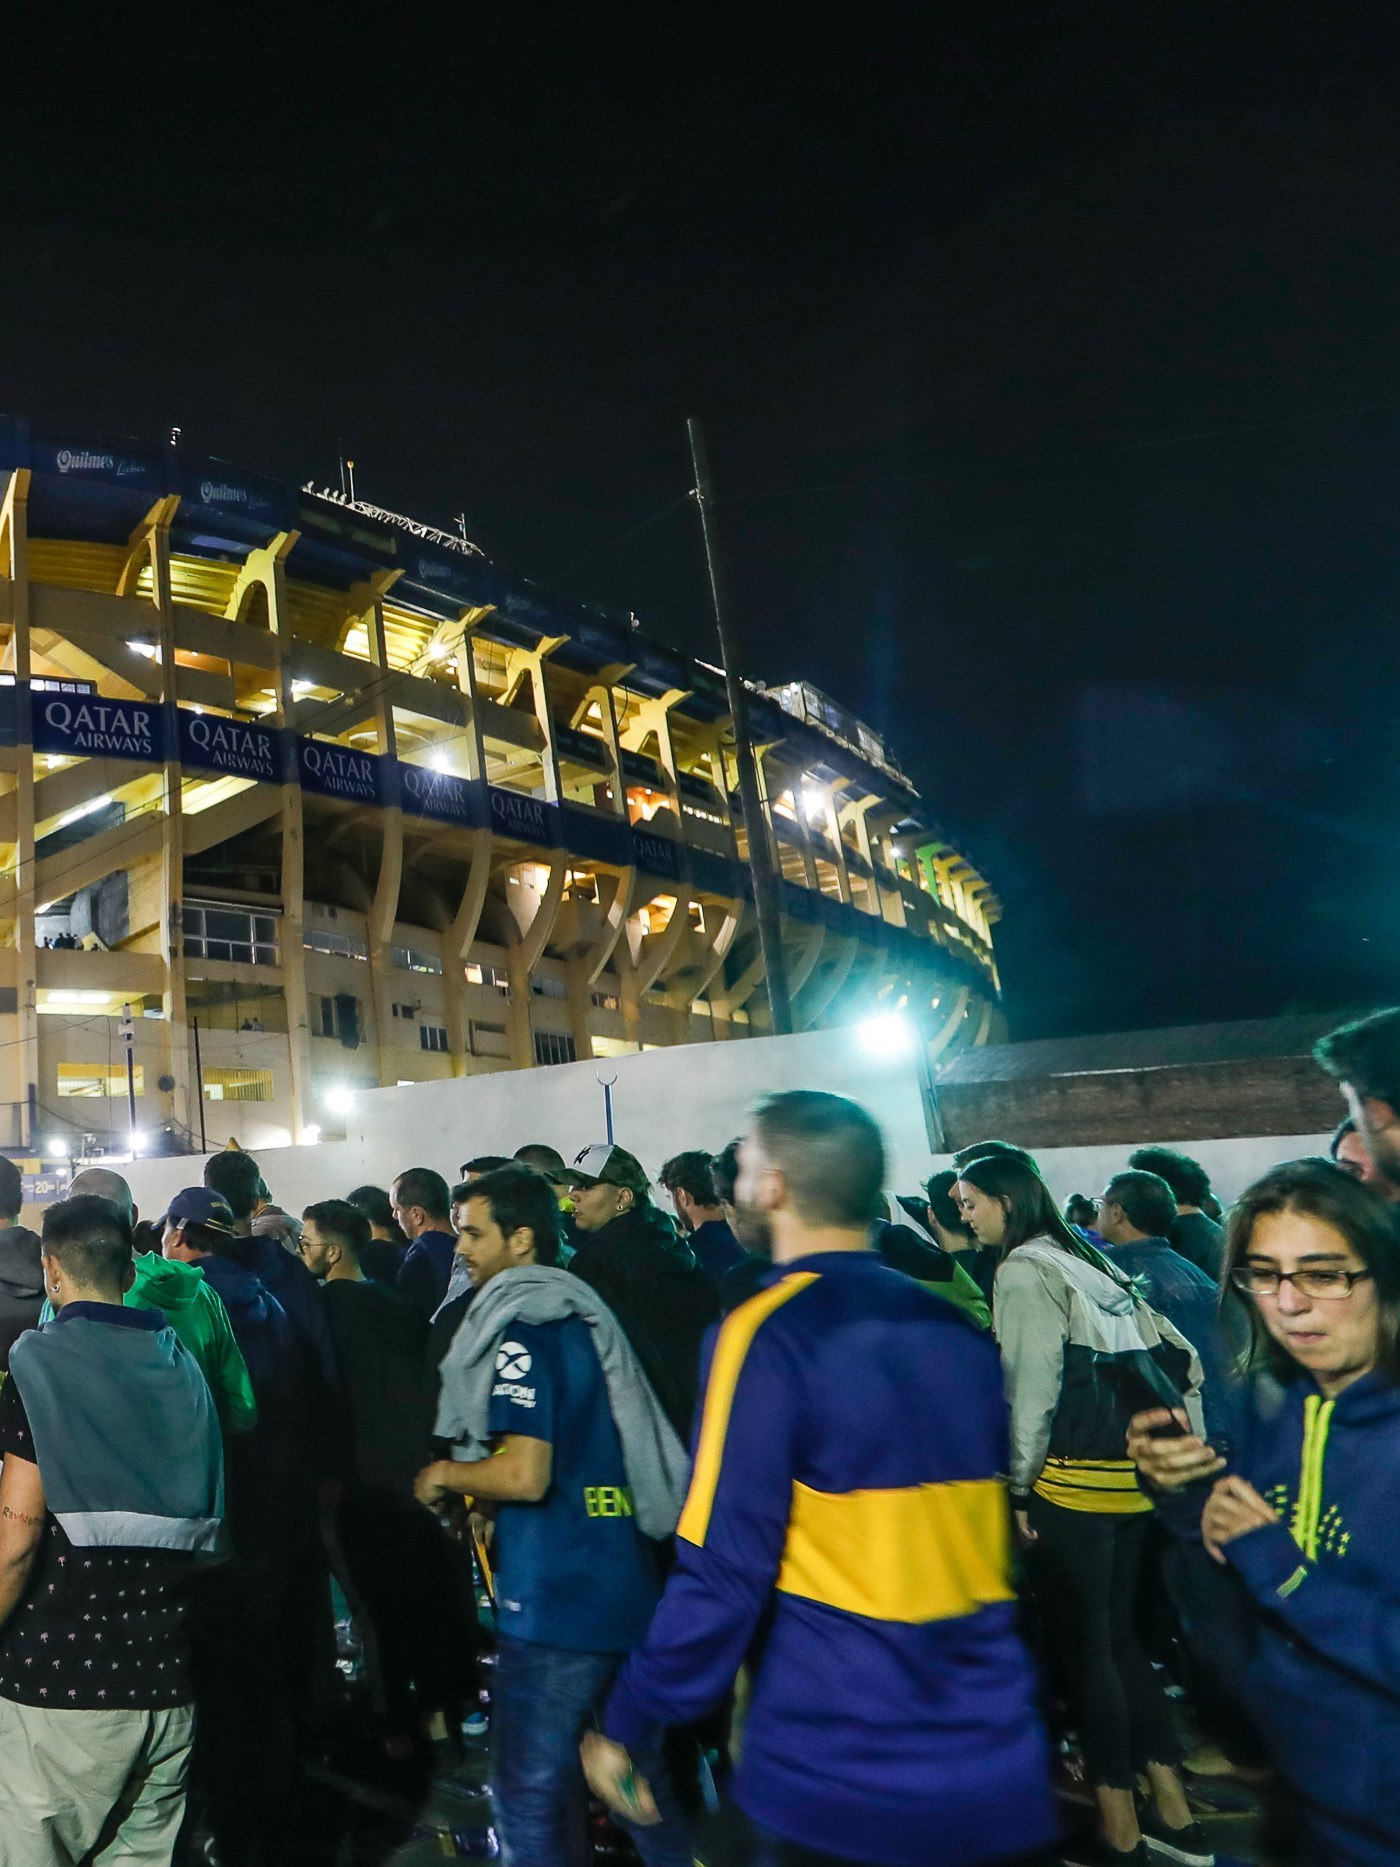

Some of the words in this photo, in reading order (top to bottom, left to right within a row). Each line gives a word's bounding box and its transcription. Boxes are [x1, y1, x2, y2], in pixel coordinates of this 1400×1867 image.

[57, 450, 114, 473] Quilmes
[45, 702, 152, 737] QATAR
[75, 732, 152, 753] AIRWAYS
[189, 719, 273, 759] QATAR
[213, 750, 274, 776] AIRWAYS
[303, 746, 374, 782] QATAR
[324, 775, 376, 798] AIRWAYS
[404, 769, 465, 803] QATAR
[422, 798, 468, 818] AIRWAYS
[491, 792, 544, 825] QATAR
